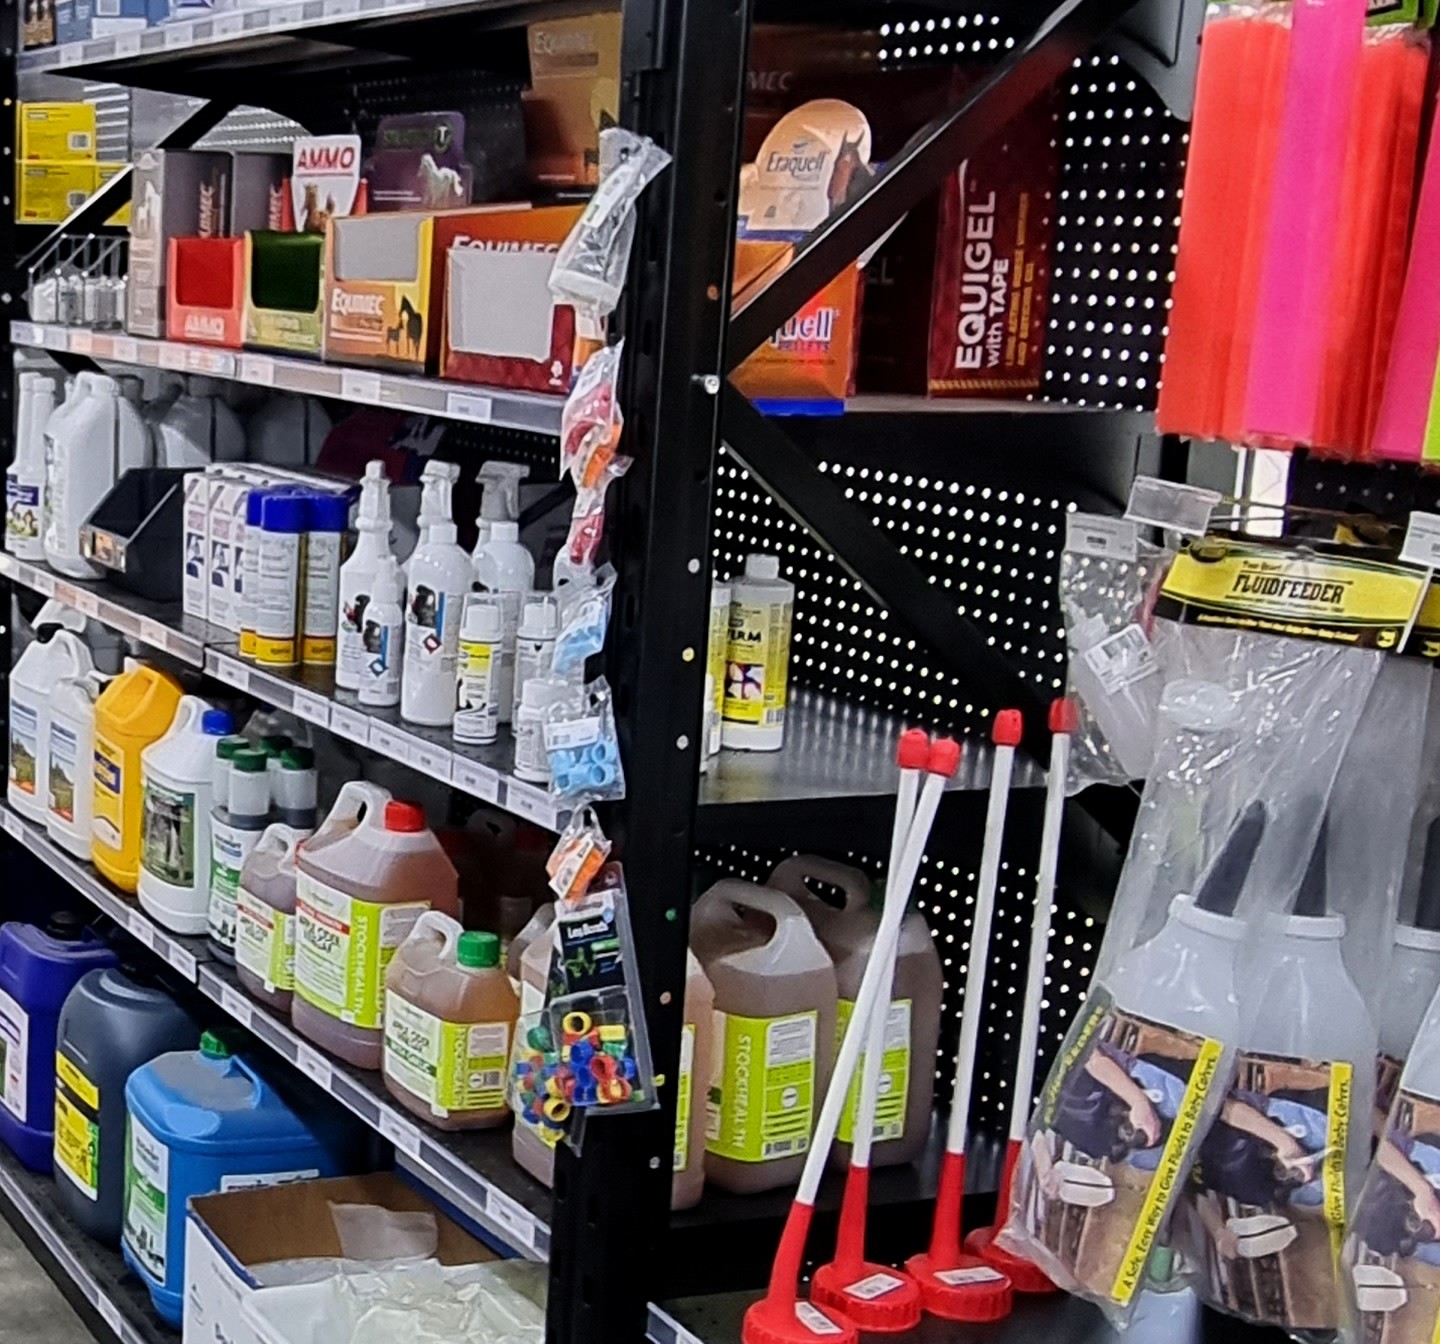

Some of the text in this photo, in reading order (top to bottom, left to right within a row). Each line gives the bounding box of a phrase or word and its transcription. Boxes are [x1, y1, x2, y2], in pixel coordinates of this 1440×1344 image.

[297, 145, 356, 170] AMMO
[766, 151, 830, 177] Eraquell
[954, 190, 996, 369] EQUIGEL
[986, 258, 1010, 368] with TAPE
[1232, 573, 1346, 605] FLUIDFEEDER
